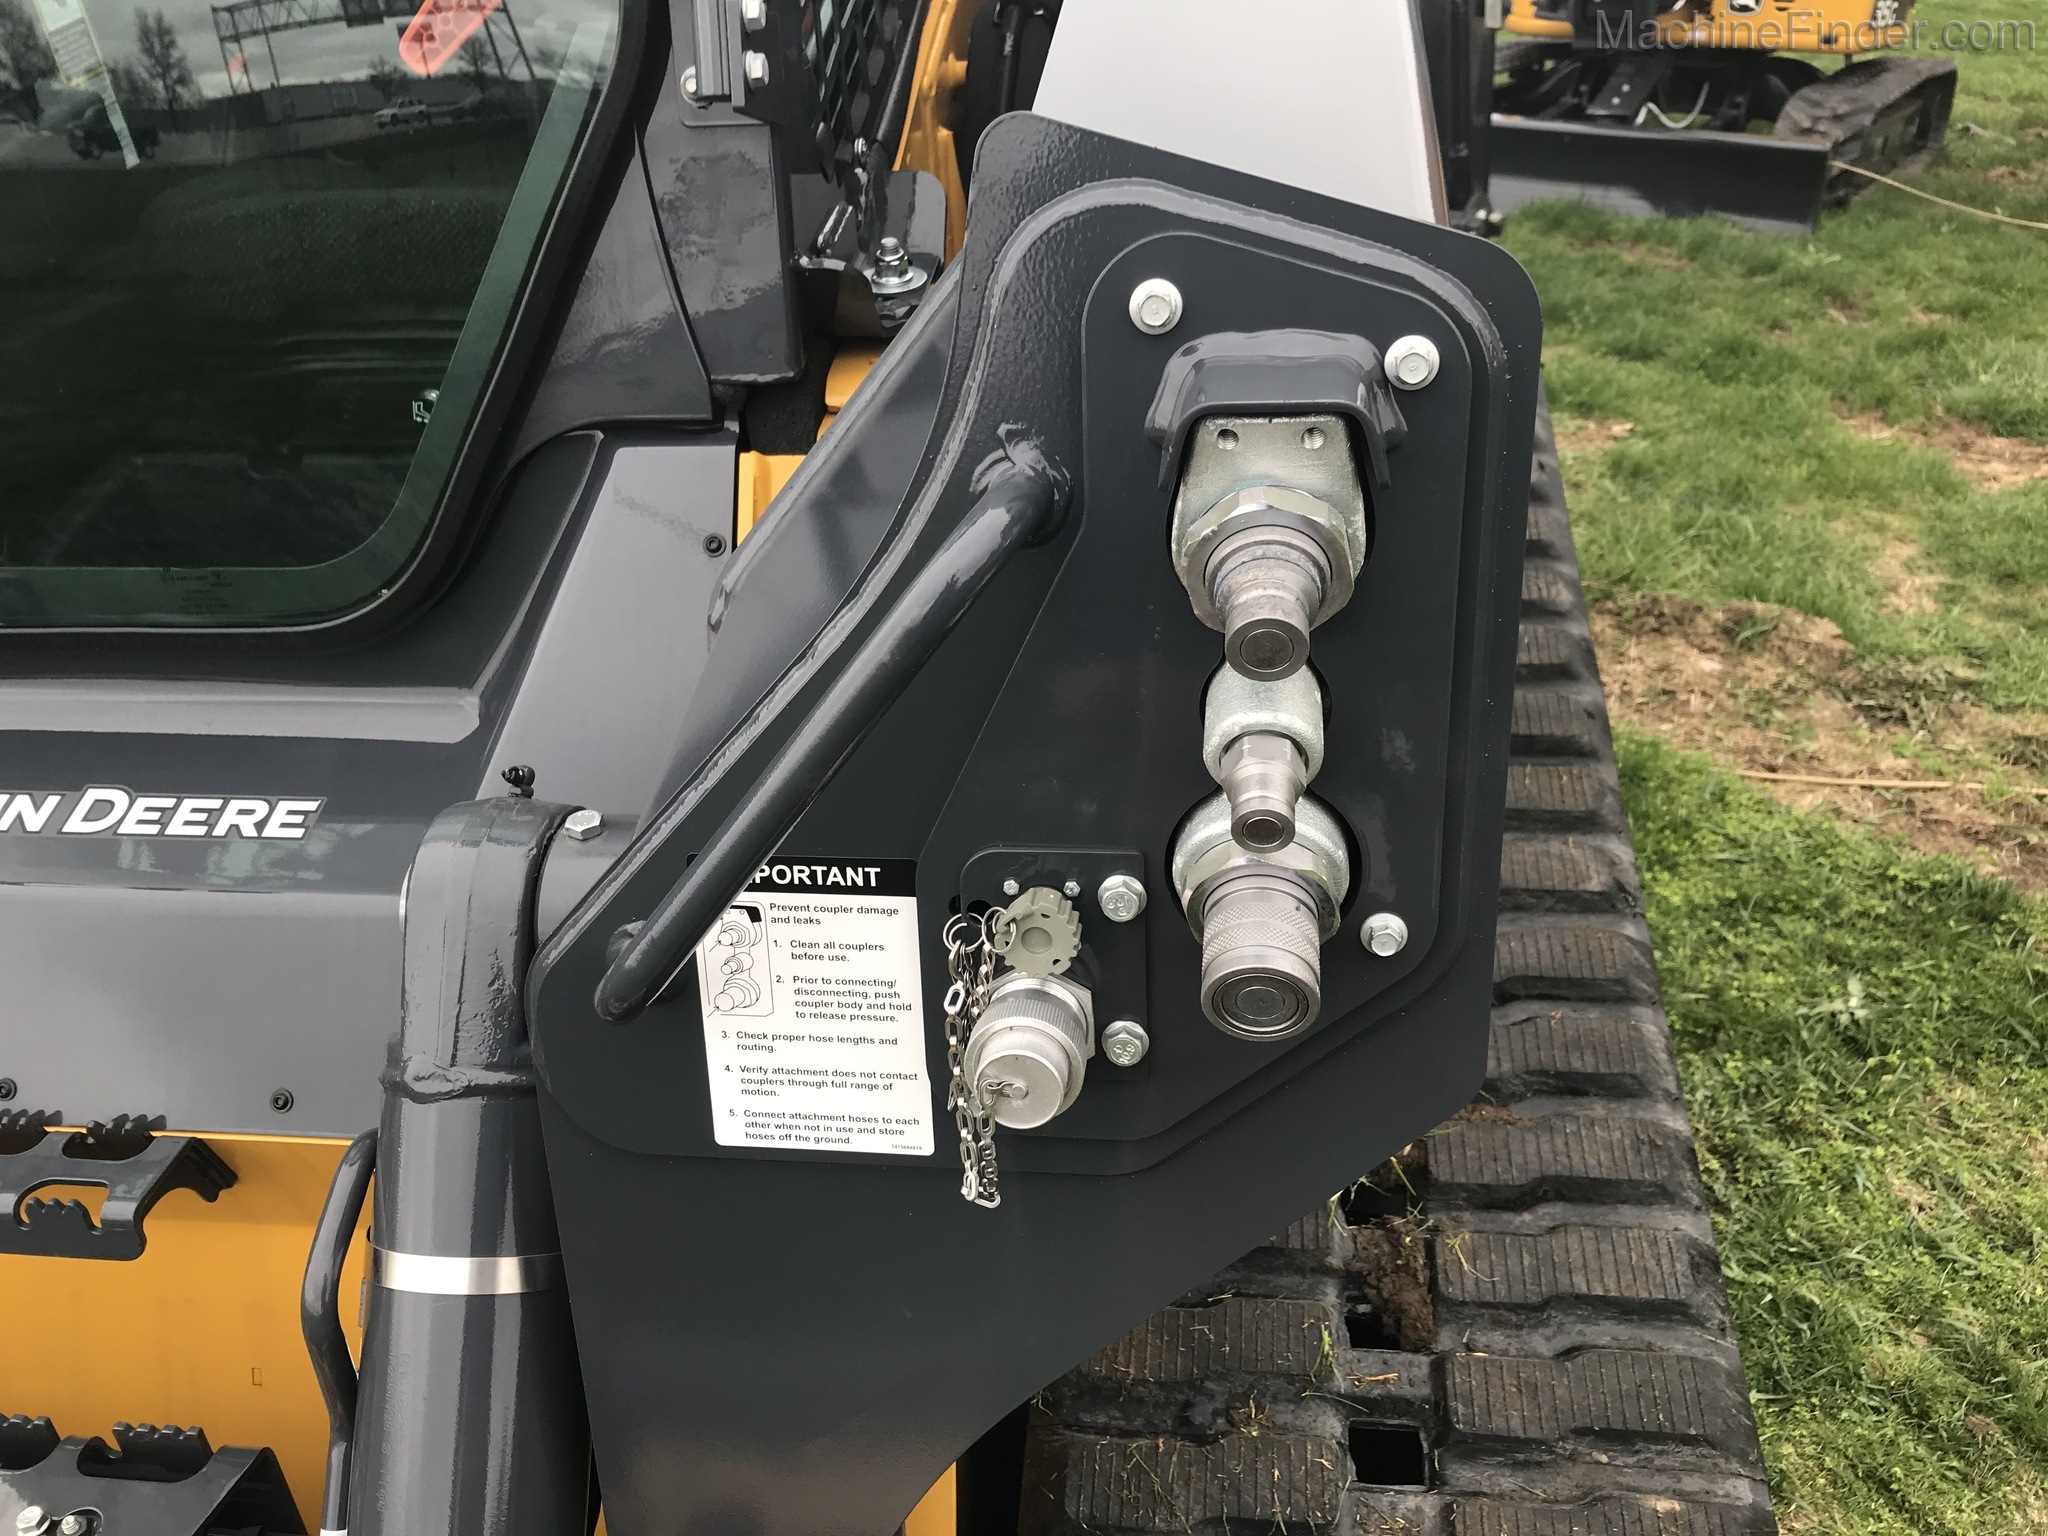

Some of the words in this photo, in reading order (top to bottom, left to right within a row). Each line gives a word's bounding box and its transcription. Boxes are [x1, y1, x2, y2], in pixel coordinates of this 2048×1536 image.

[61, 788, 322, 839] DEERE
[750, 864, 881, 887] PORTANT
[769, 903, 811, 912] Prevent
[813, 905, 854, 915] coupler
[857, 906, 899, 917] damage
[771, 916, 790, 924] and
[793, 916, 821, 925] leaks
[773, 939, 782, 948] 1.
[790, 940, 820, 949] Clean
[823, 941, 835, 949] all
[838, 942, 885, 952] couplers
[791, 952, 825, 961] before
[776, 975, 784, 983] 2.
[793, 975, 818, 984] Prior
[821, 977, 832, 985] to
[835, 978, 897, 989] connecting/
[794, 987, 871, 1000] disconnecting,
[874, 991, 900, 1000] push
[795, 1000, 834, 1009] coupler
[837, 1000, 863, 1011] body
[866, 1002, 886, 1010] and
[889, 1002, 912, 1011] hold
[809, 1011, 846, 1020] release
[850, 1014, 898, 1022] pressure.
[721, 1030, 730, 1038] 3.
[736, 1031, 768, 1040] Check
[771, 1034, 806, 1043] proper
[809, 1034, 834, 1043] hose
[837, 1035, 875, 1046] lengths
[878, 1037, 898, 1045] and
[737, 1044, 776, 1053] routing.
[739, 1065, 768, 1076] Verify
[771, 1067, 829, 1077] attachment
[831, 1069, 857, 1078] does
[860, 1071, 877, 1079] not
[879, 1073, 918, 1081] contact
[740, 1077, 785, 1086] couplers
[788, 1078, 828, 1089] through
[831, 1080, 847, 1088] full
[850, 1083, 879, 1091] range
[741, 1088, 779, 1096] motion.
[744, 1109, 786, 1119] Connect
[789, 1113, 845, 1122] attachment
[848, 1115, 879, 1123] hoses
[745, 1121, 771, 1129] other
[774, 1122, 801, 1130] when
[879, 1128, 905, 1136] store
[745, 1132, 776, 1140] hoses
[778, 1133, 792, 1141] off
[795, 1134, 810, 1142] the
[813, 1137, 853, 1145] ground.
